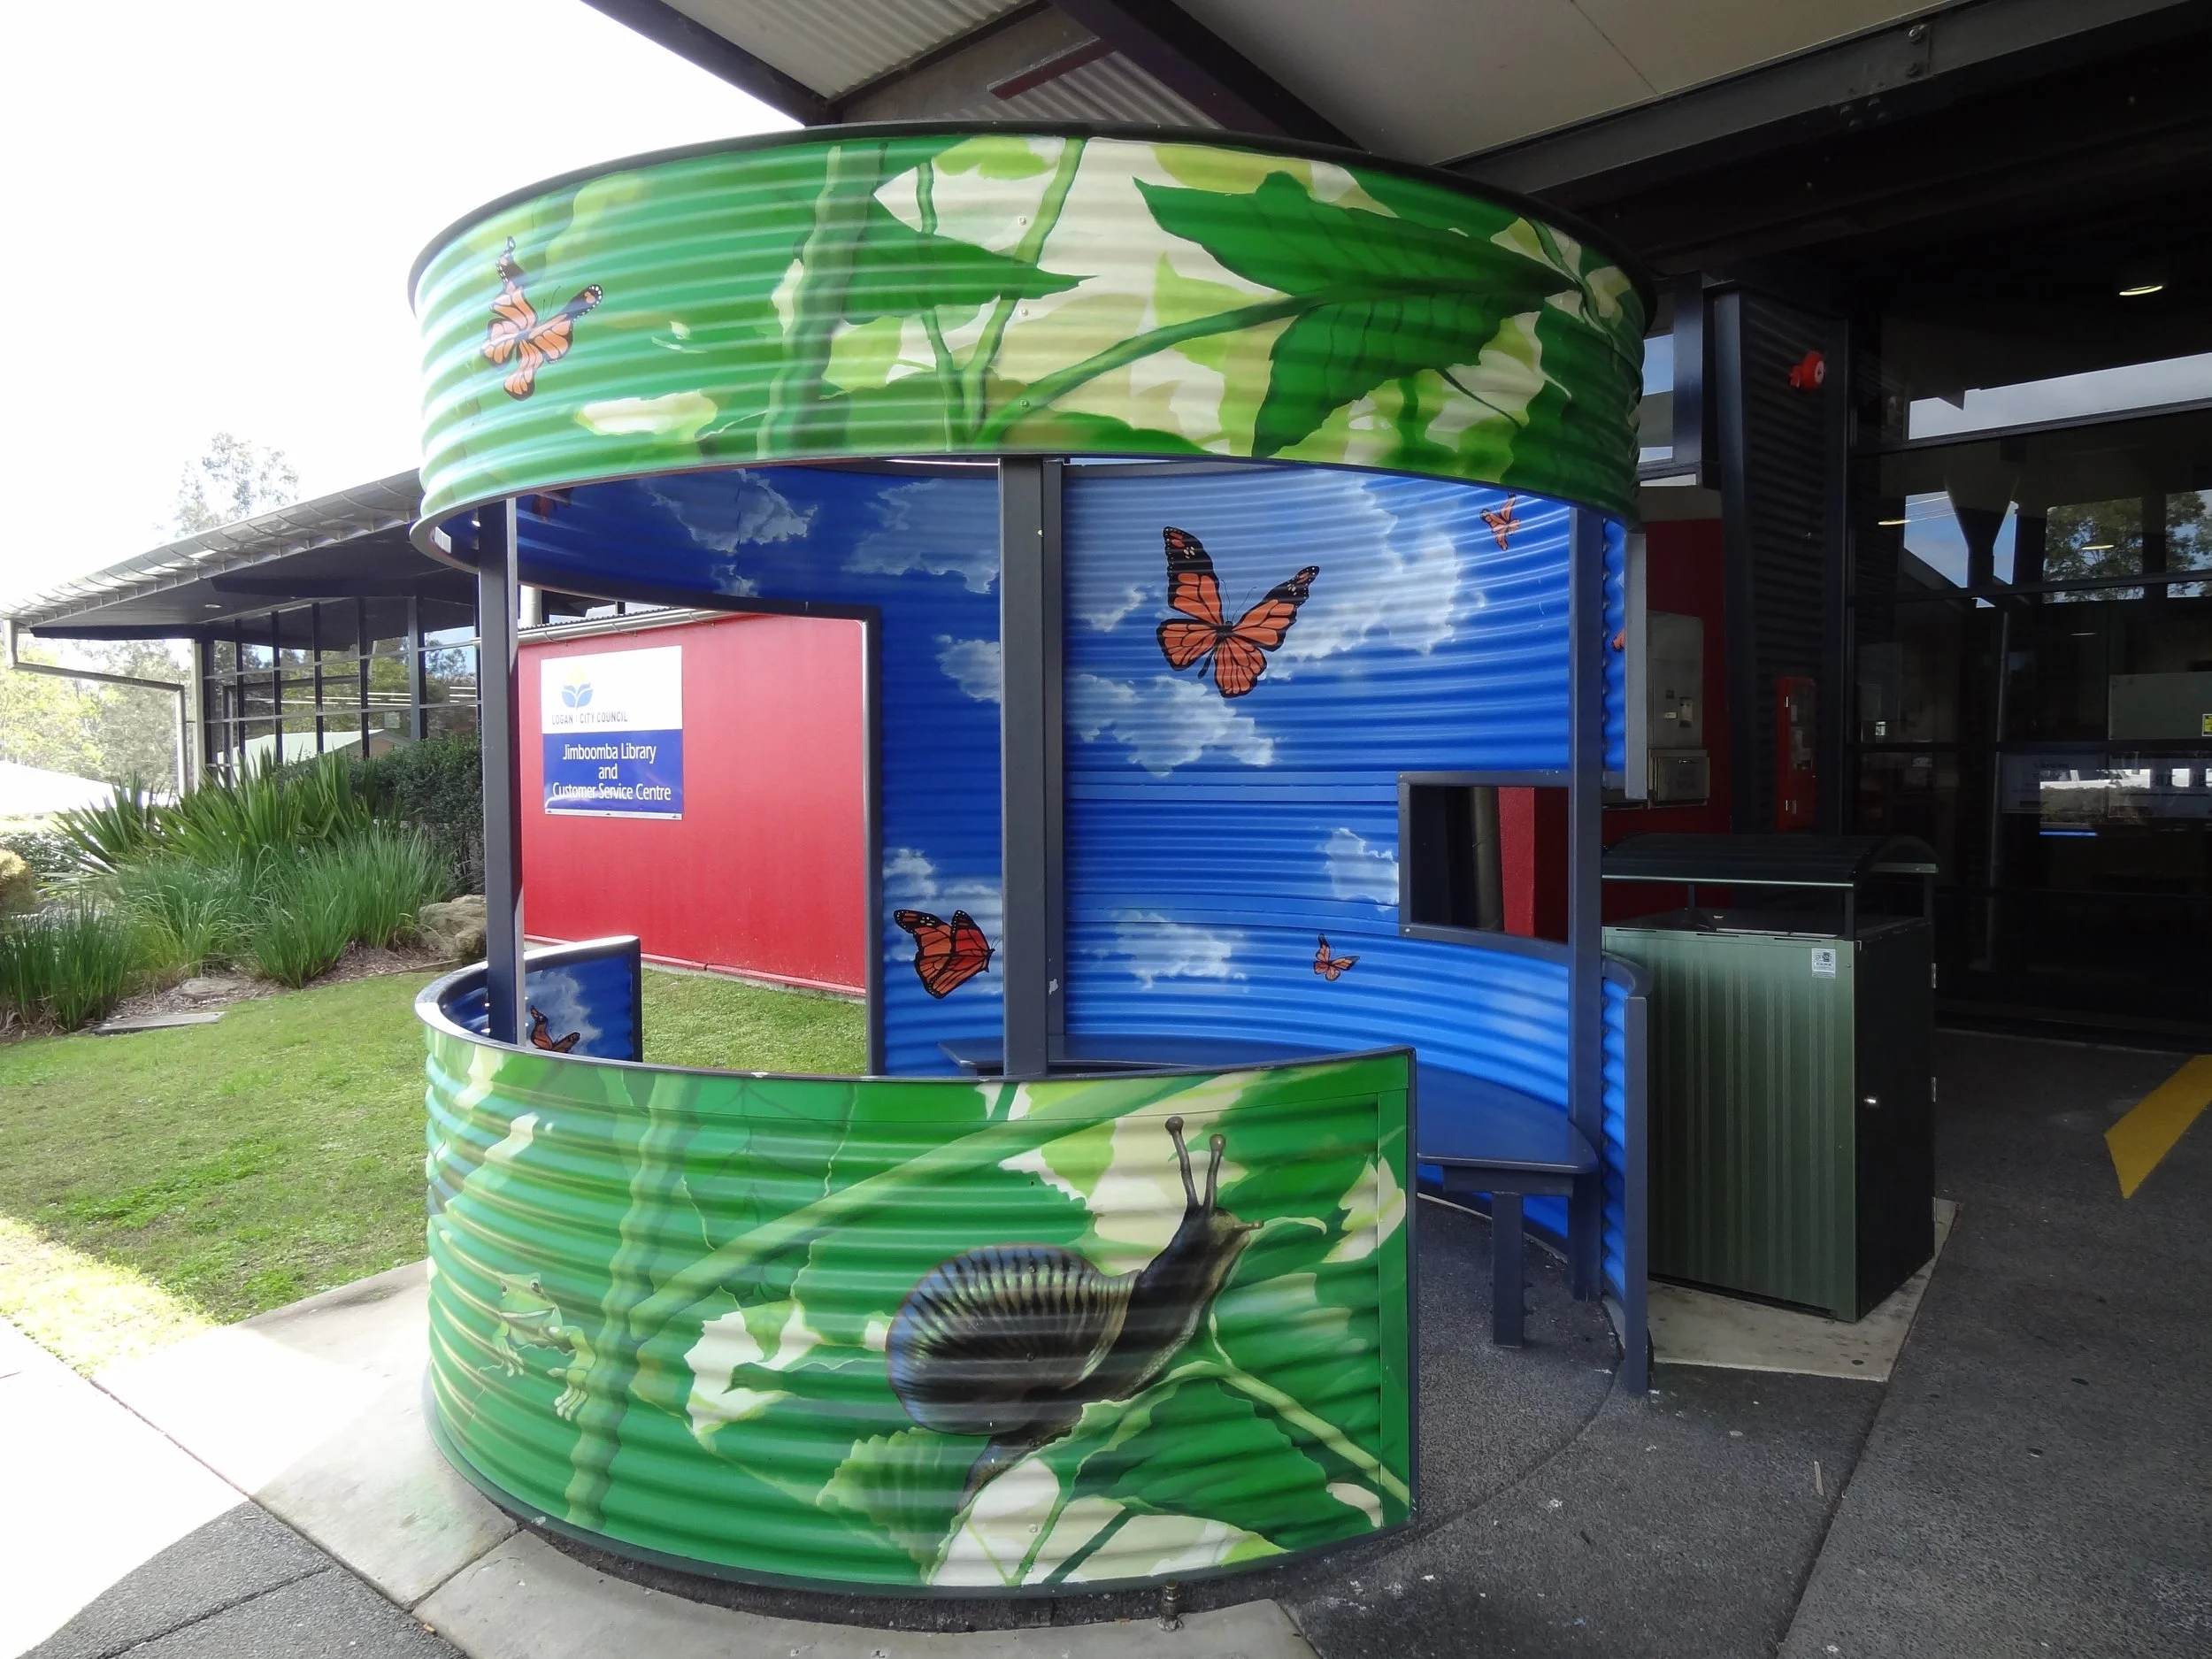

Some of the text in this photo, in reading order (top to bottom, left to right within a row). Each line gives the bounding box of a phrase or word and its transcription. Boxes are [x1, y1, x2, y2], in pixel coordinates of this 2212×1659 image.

[552, 711, 628, 725] LOGAN CITY COUNCIL
[562, 742, 657, 764] Jimboomba Library
[598, 763, 618, 780] and
[553, 782, 671, 801] Customer Service Centre
